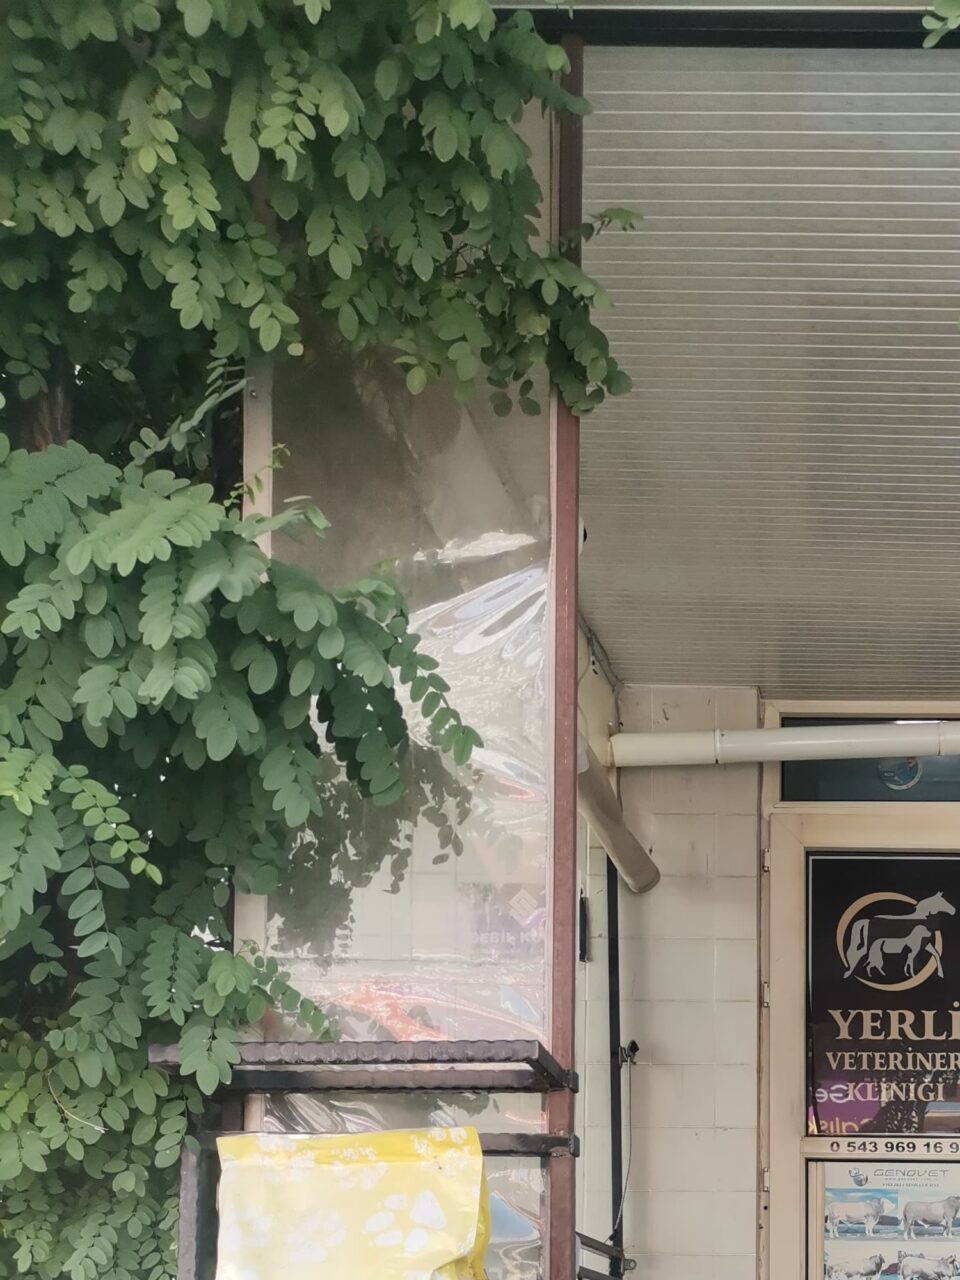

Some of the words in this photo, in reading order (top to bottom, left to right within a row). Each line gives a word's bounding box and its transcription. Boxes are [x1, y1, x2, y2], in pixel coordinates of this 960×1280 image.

[849, 1077, 945, 1102] KLİNİĞİ
[830, 1141, 840, 1152] 0
[847, 1141, 878, 1152] 543
[885, 1141, 916, 1152] 969
[923, 1142, 943, 1153] 16
[873, 1168, 950, 1177] GENOVET
